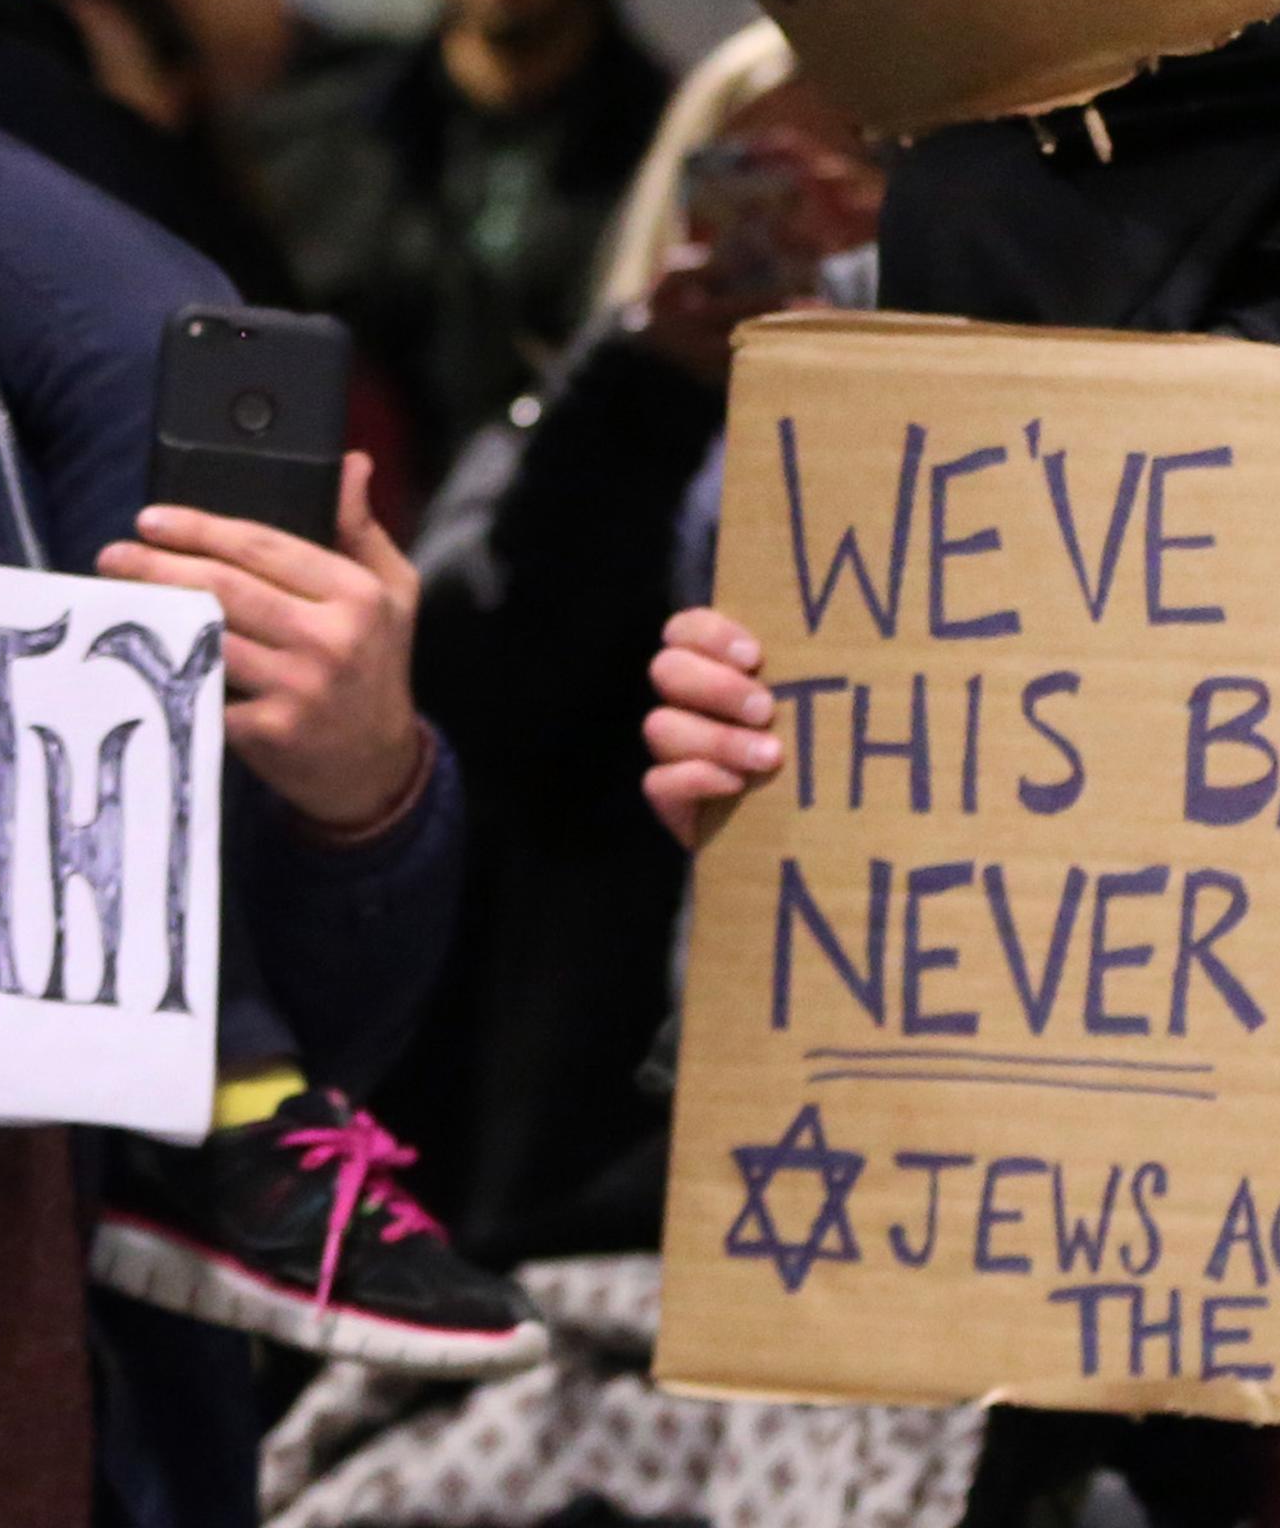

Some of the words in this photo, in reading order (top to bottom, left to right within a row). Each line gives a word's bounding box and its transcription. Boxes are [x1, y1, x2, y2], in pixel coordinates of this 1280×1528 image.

[777, 416, 1234, 639] WE'VE
[768, 672, 1088, 814] THIS
[769, 858, 1268, 1038] NEVER
[887, 1150, 1170, 1276] JEWS
[1046, 1282, 1274, 1382] THE
